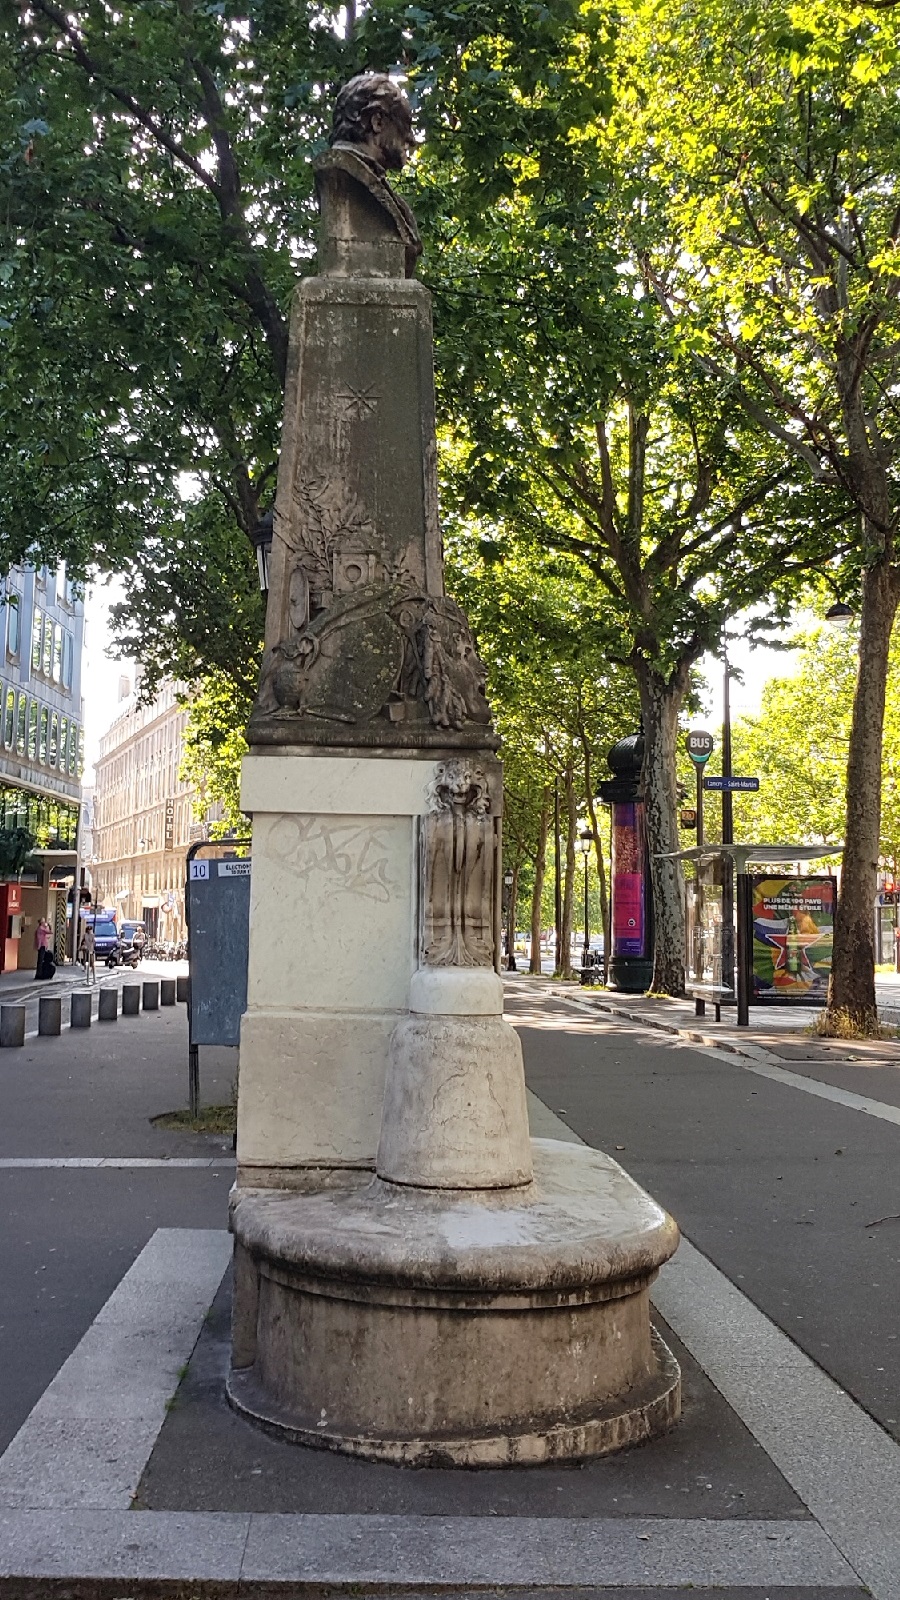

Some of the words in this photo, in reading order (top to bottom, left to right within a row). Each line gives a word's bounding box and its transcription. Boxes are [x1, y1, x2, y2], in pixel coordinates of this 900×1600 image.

[690, 738, 710, 748] BUS
[707, 780, 723, 788] Lancry
[728, 780, 757, 788] Saint-Martin
[166, 799, 174, 839] HOTEL
[193, 865, 206, 878] 10
